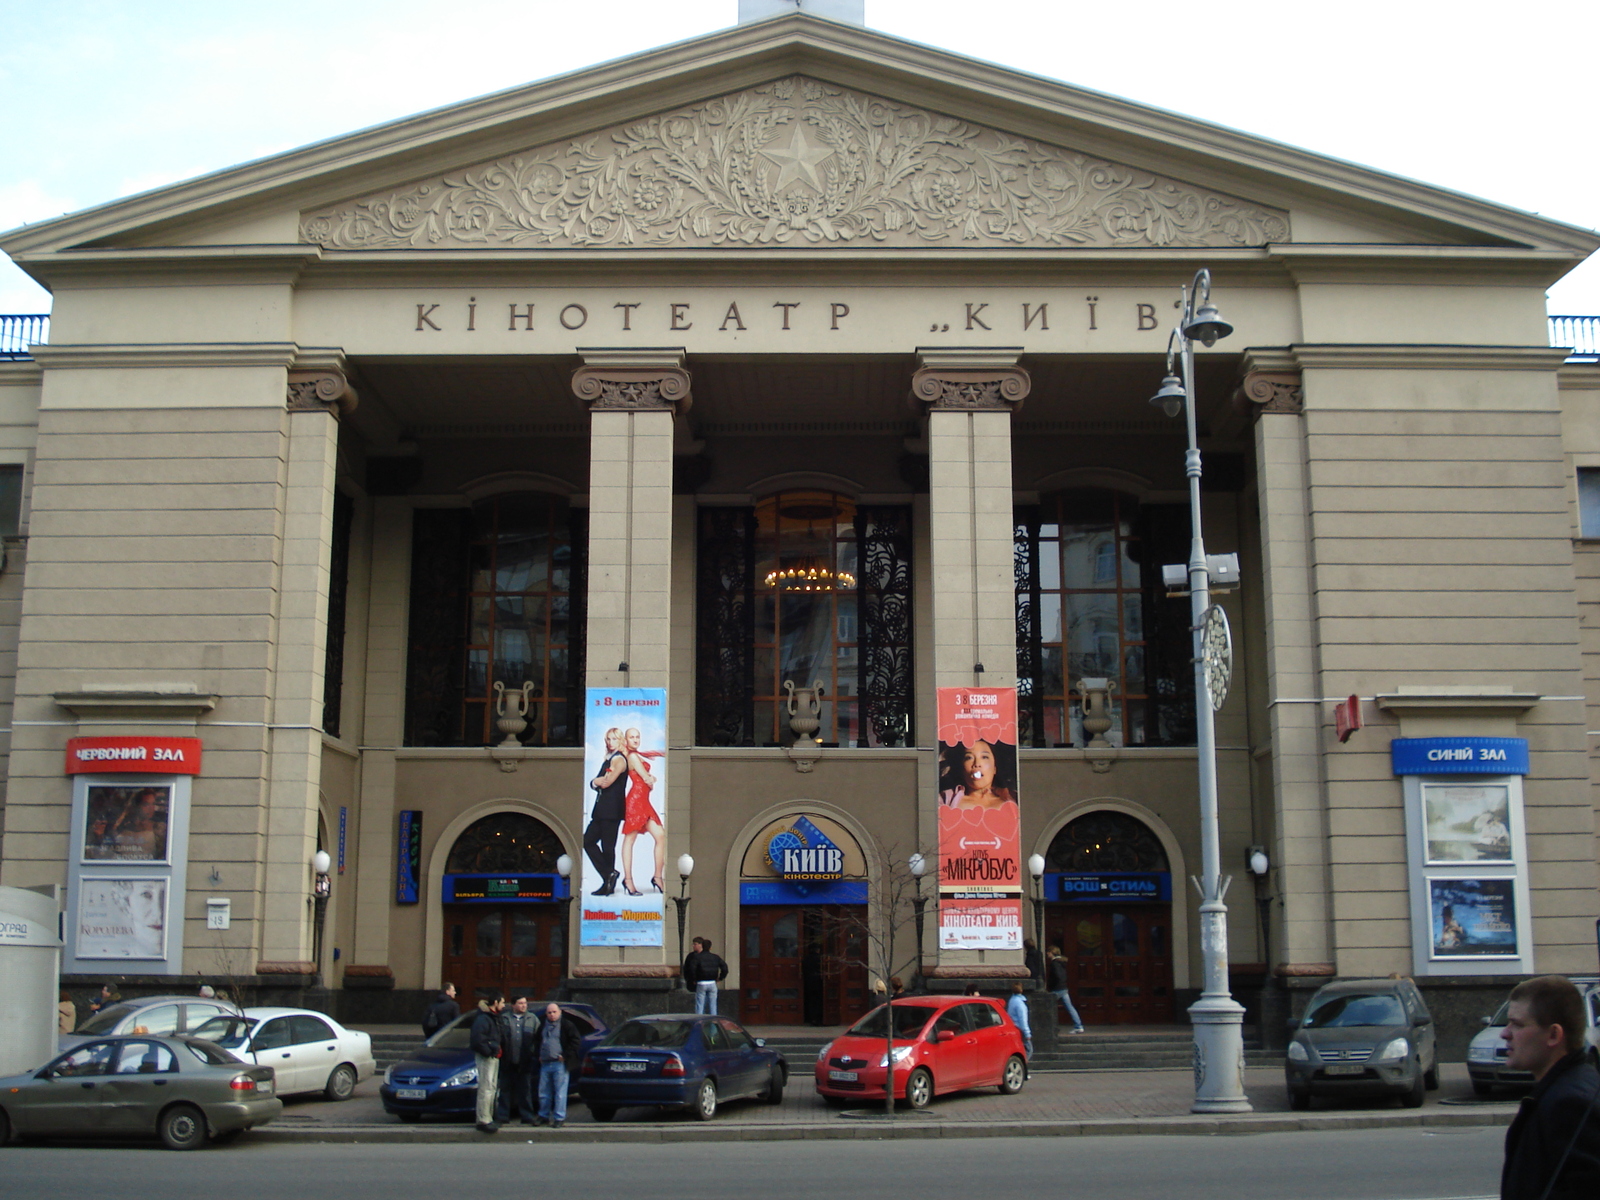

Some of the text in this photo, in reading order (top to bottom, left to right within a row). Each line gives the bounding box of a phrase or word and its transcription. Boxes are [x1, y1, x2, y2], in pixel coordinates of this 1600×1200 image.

[415, 296, 851, 331] КІНОТЕАТР
[603, 696, 613, 706] 8
[955, 694, 998, 705] З 8 БЕРЕЗНЯ
[77, 746, 184, 761] ЧЕРВОНИЙ ЗАЛ
[1427, 747, 1507, 761] СИНІЙ ЗАЛ
[399, 813, 409, 900] ТЕАТРАЛЬНА
[784, 844, 842, 873] КИЇВ
[942, 858, 1018, 881] «МІКРОБУС»
[1109, 881, 1156, 892] СТИЛЬ
[943, 914, 993, 928] КІНОТЕАТР
